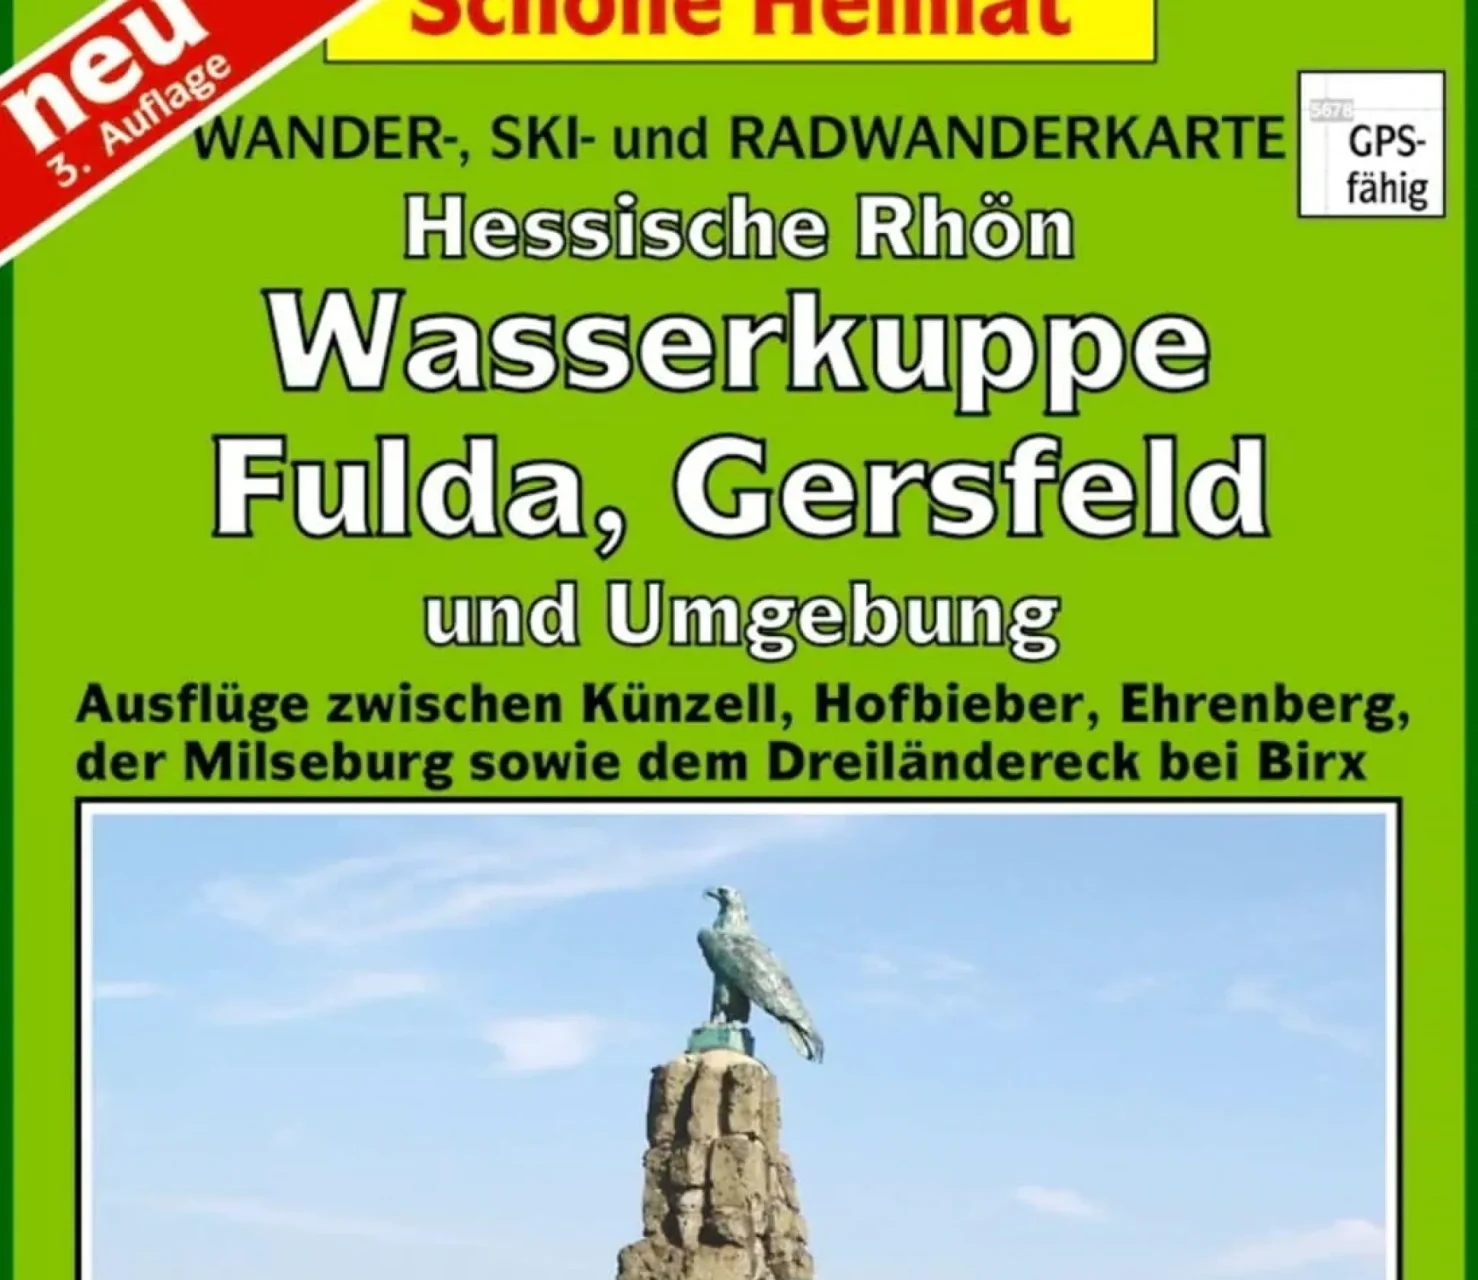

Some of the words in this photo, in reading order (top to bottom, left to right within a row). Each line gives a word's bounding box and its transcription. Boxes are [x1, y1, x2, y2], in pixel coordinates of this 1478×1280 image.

[3, 0, 210, 154] neu
[46, 152, 92, 188] 3.
[99, 54, 231, 157] Auflage
[194, 115, 469, 167] WANDER-,
[491, 115, 596, 160] SKI-
[613, 115, 708, 160] und
[731, 115, 1286, 160] RADWANDERKARTE
[1349, 124, 1427, 157] GPS-
[403, 191, 830, 261] Hessische
[855, 191, 1076, 261] Rhön
[1346, 171, 1429, 212] fähig
[260, 288, 1212, 417] Wasserkuppe
[211, 434, 628, 561] Fulda,
[671, 433, 1272, 541] Gersfeld
[422, 580, 581, 648] und
[605, 580, 1062, 663] Umgebung
[75, 682, 309, 734] Ausflüge
[326, 682, 562, 723] zwischen
[582, 682, 793, 731] Künzell,
[815, 682, 1099, 731] Hofbieber,
[1122, 682, 1409, 734] Ehrenberg,
[76, 740, 167, 782] der
[184, 740, 454, 791] Milseburg
[469, 740, 620, 782] sowie
[638, 740, 748, 782] dem
[768, 740, 1140, 782] Dreiländereck
[1160, 740, 1238, 782] bei
[1259, 740, 1367, 782] Birx
